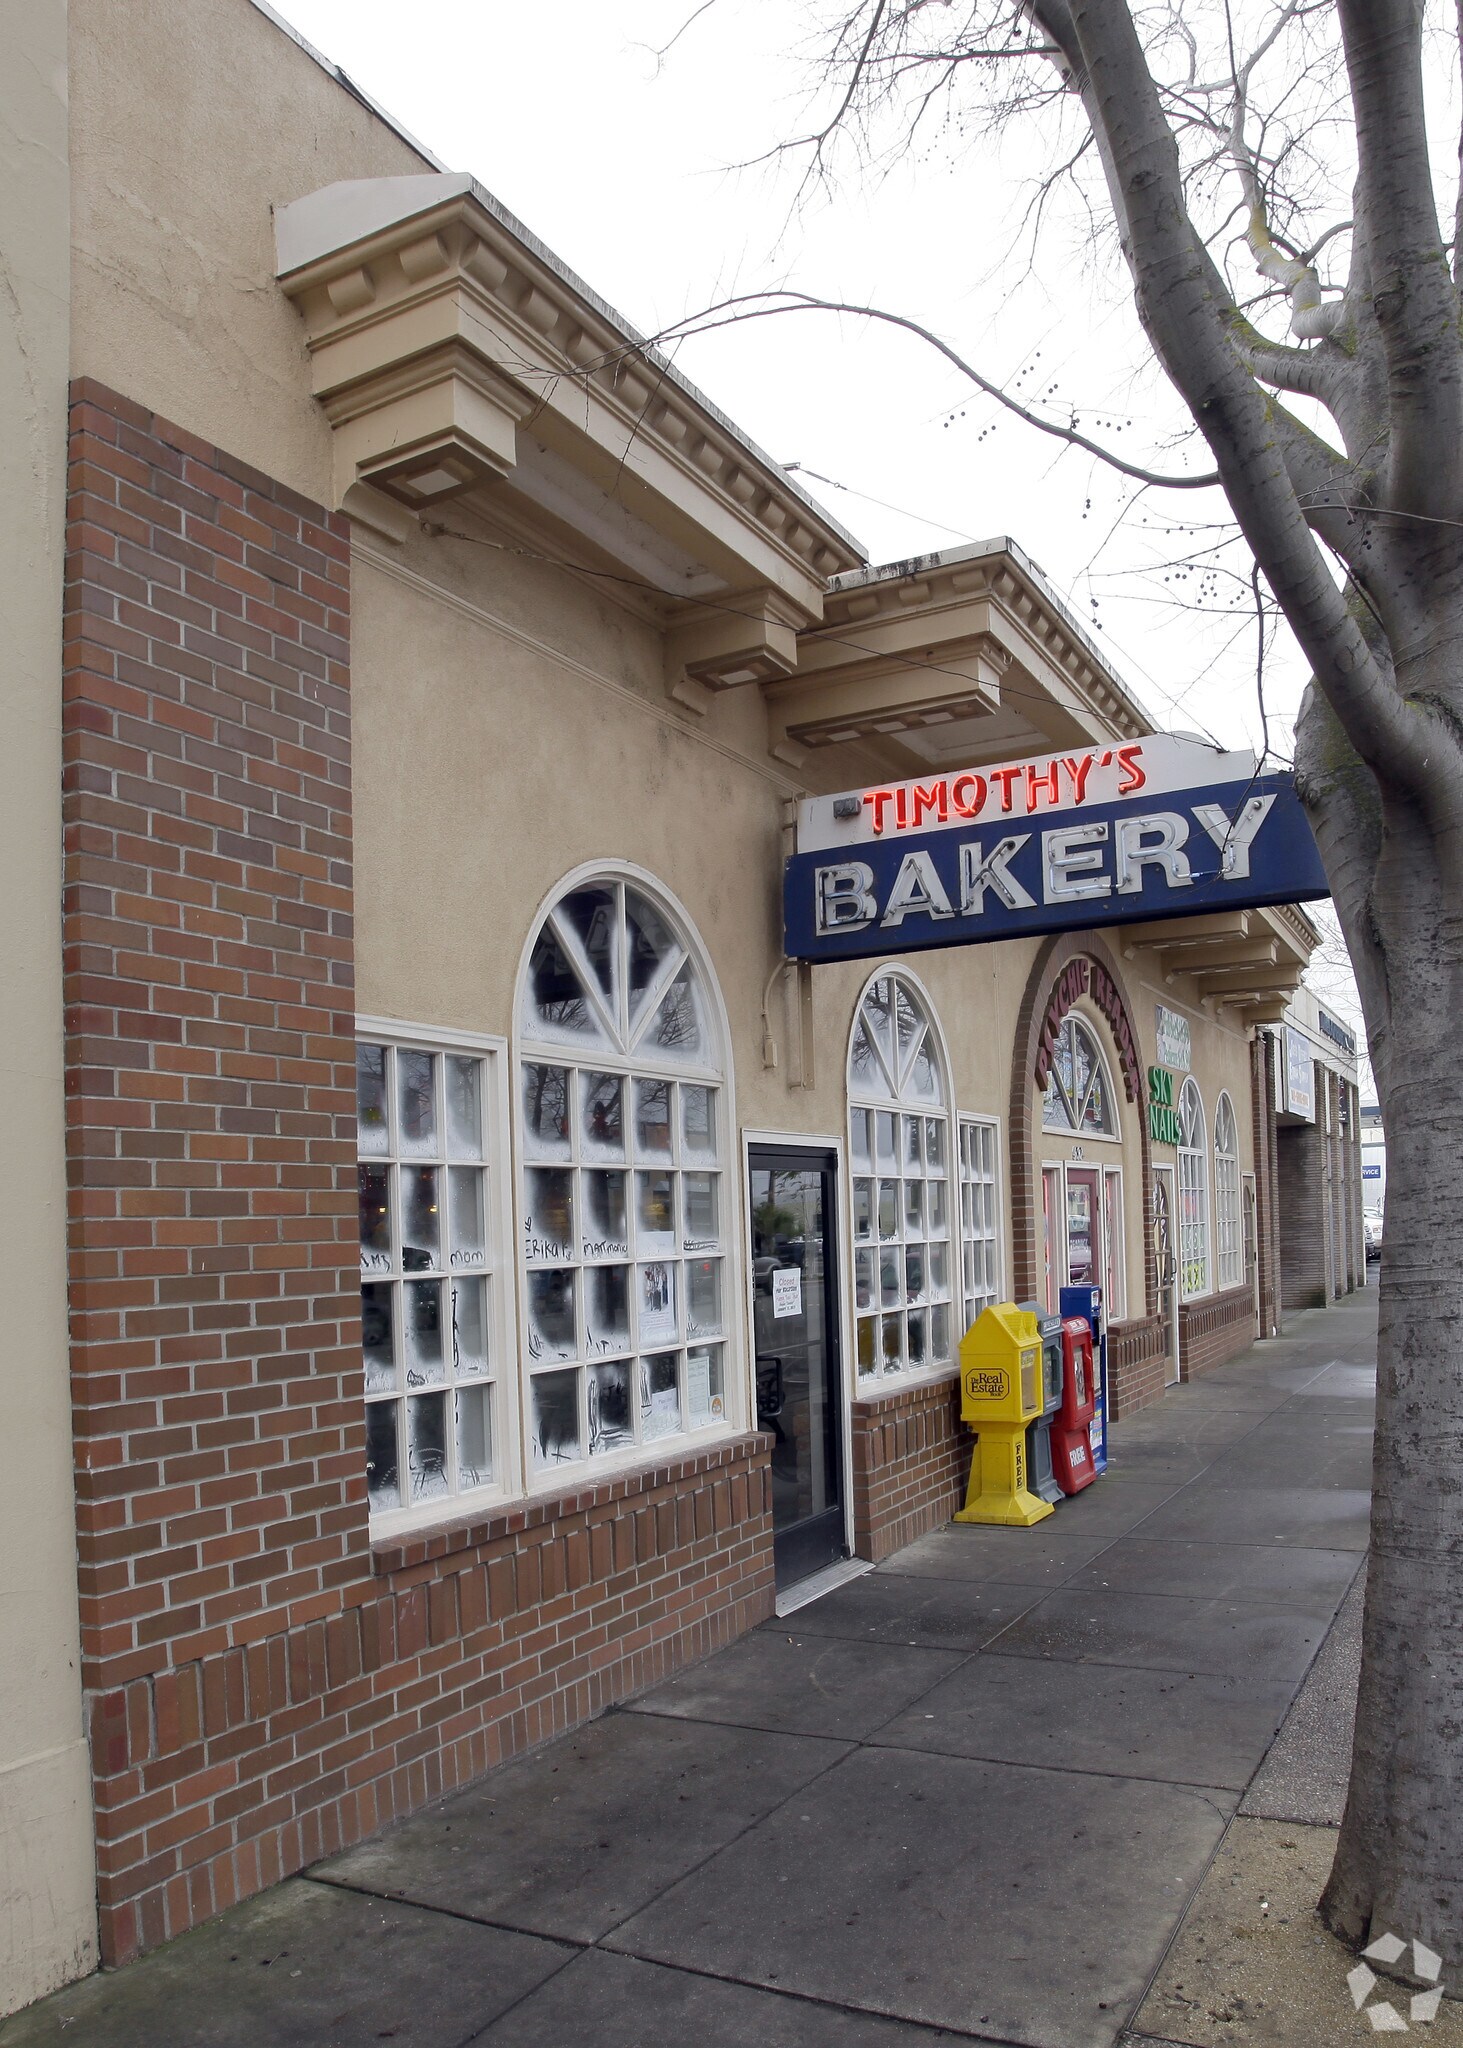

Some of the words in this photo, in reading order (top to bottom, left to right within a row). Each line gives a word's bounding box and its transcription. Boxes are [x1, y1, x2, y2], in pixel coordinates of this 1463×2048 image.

[862, 744, 1146, 835] TIMOTHY'S
[814, 793, 1277, 937] BAKERY
[1035, 958, 1090, 1092] PSYCHIC
[1090, 965, 1140, 1104] READER
[1148, 1066, 1173, 1106] SKY
[1149, 1104, 1182, 1146] NAILS
[971, 1382, 1005, 1393] Estate
[979, 1372, 1003, 1384] Real
[1070, 1446, 1086, 1467] FREE
